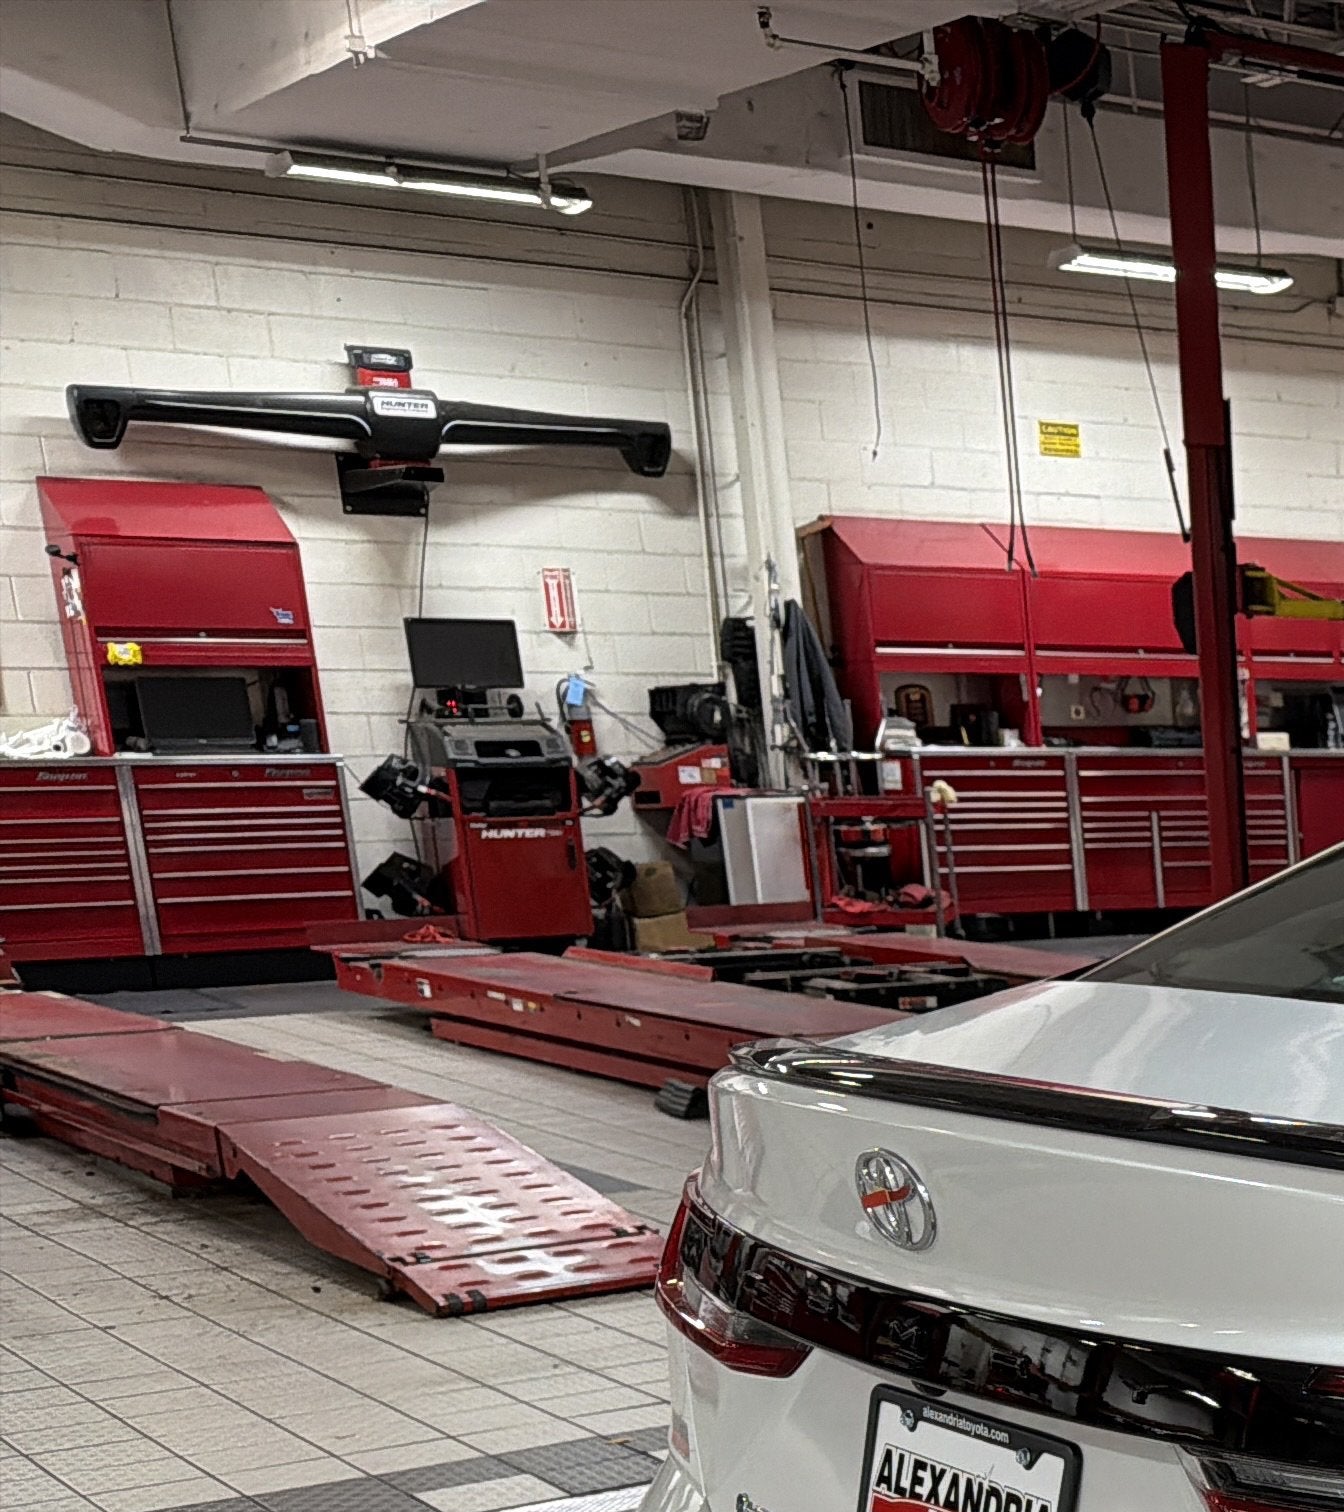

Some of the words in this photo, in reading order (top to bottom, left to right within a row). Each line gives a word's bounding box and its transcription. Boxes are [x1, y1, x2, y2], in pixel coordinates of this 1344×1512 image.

[381, 400, 429, 409] HUNTER
[481, 828, 546, 840] HUNTER
[922, 1406, 1010, 1444] alexandriatoyota.com
